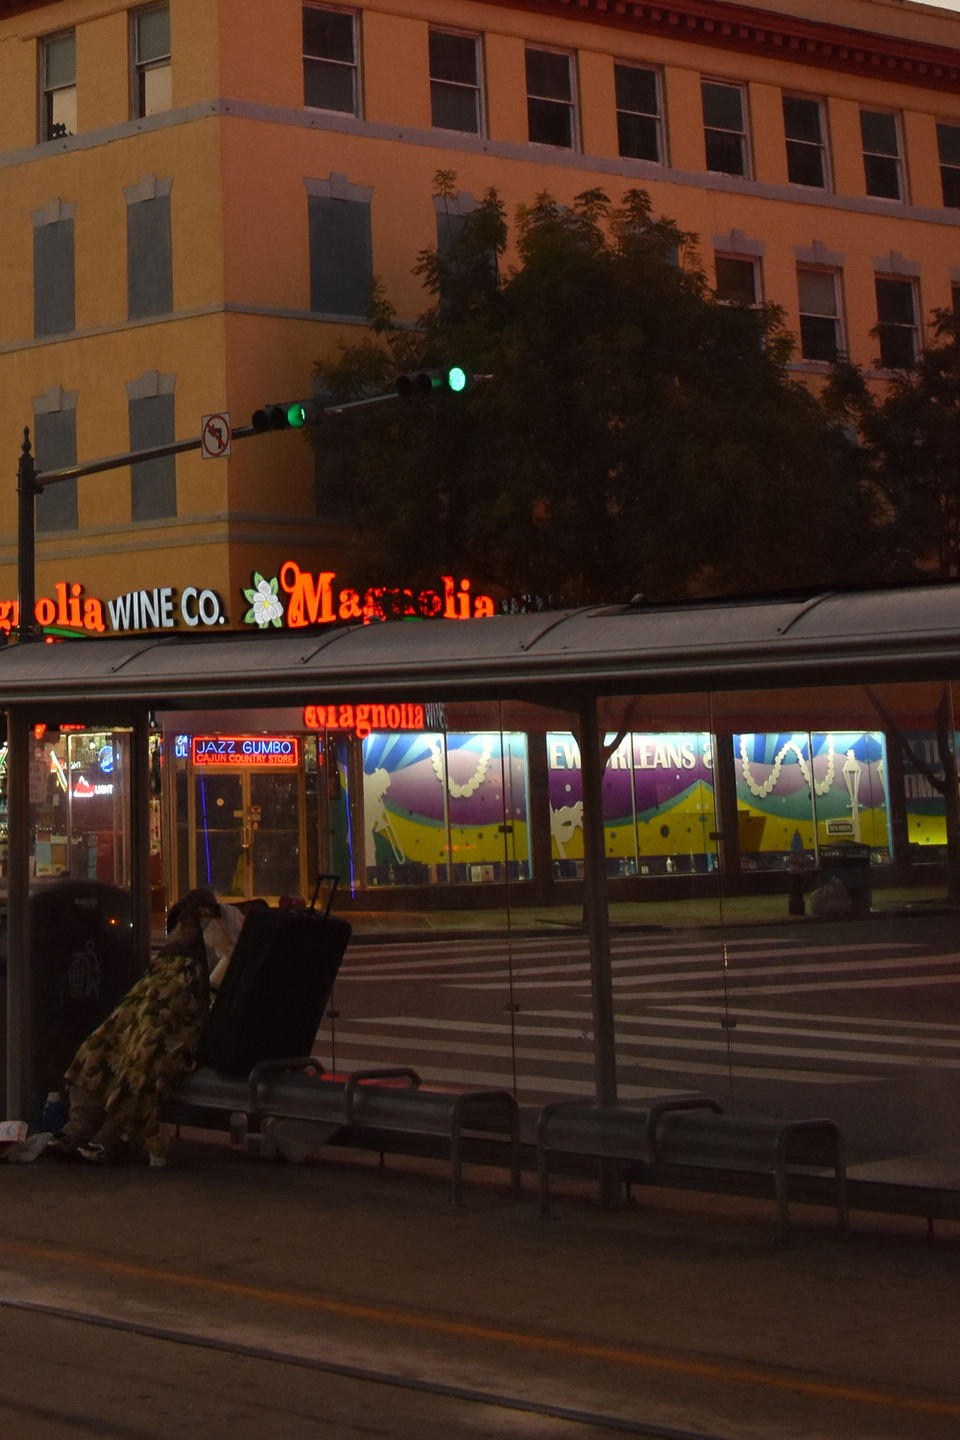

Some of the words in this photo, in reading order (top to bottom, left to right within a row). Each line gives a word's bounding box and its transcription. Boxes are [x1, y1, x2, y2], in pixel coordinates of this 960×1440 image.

[108, 587, 174, 632] WINE
[180, 587, 226, 626] CO.
[196, 741, 236, 754] JAZZ
[242, 740, 292, 754] GUMBO
[606, 743, 696, 769] RLEANS
[196, 754, 227, 762] CAJUN
[229, 754, 266, 763] COUNTRY
[268, 754, 294, 763] STORE
